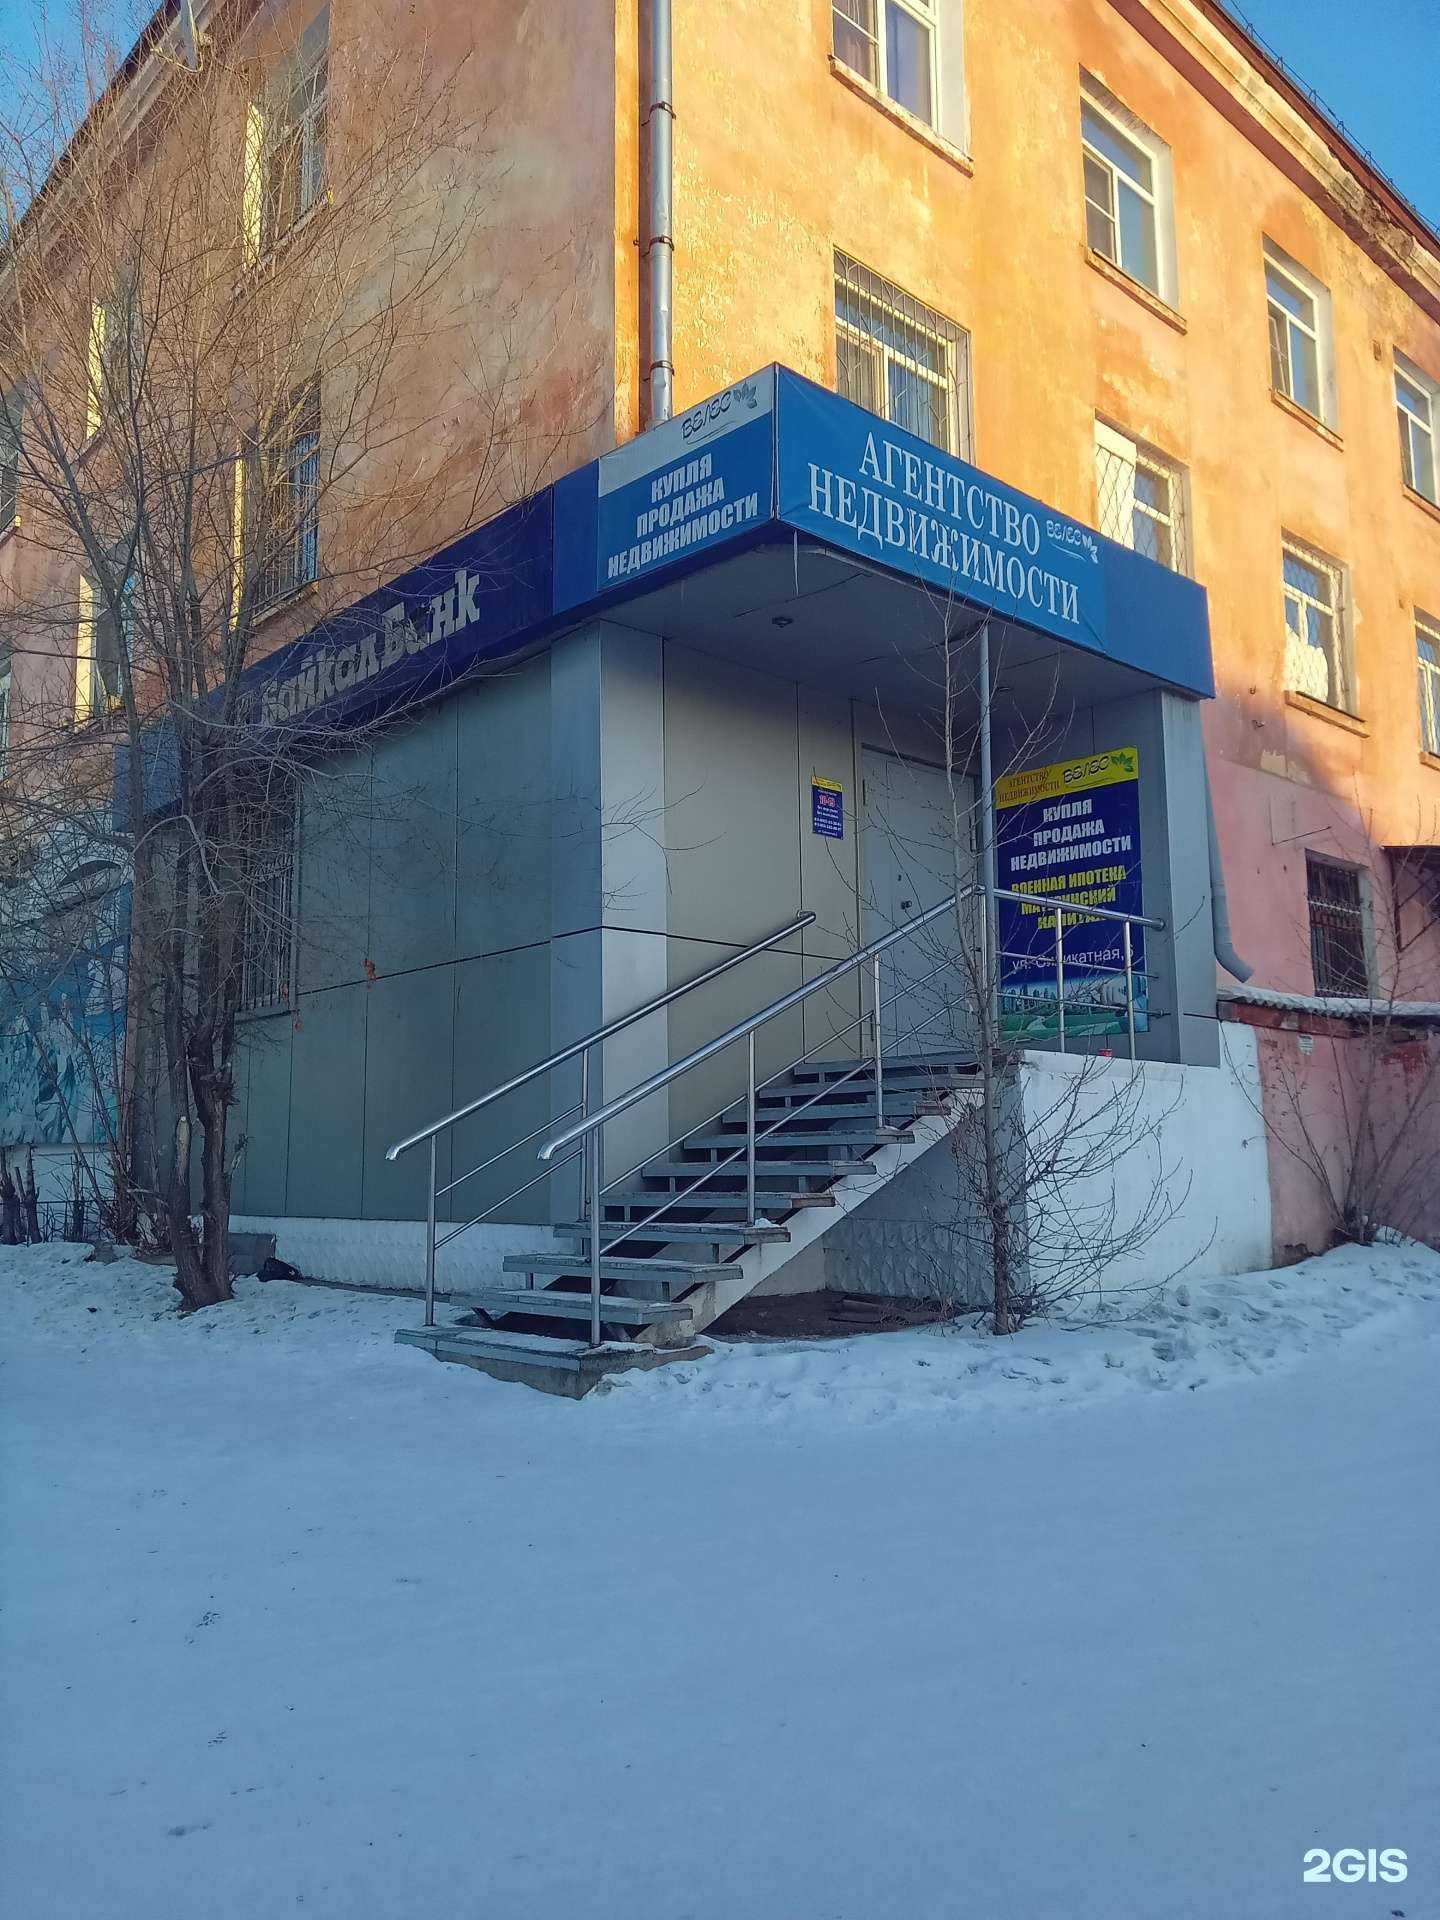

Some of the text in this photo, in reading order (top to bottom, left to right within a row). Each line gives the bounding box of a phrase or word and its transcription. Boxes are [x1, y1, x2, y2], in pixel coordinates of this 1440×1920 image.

[651, 452, 712, 504] КУПЛЯ
[858, 431, 1041, 556] АГЕНТСТВО
[636, 476, 725, 538] ПРОДАЖА
[607, 492, 758, 579] НЕДВИЖИМОСТИ
[807, 462, 1080, 625] НЕДВИЖИМОСТИ
[1043, 798, 1093, 823] КУПЛЯ
[1033, 818, 1105, 847] ПРОДАЖА
[1010, 835, 1132, 872] НЕДВИЖИМОСТИ
[1011, 865, 1127, 897] ВОЕННАЯ ИПОТЕКА
[1021, 884, 1117, 915] МАИНСКИЙ
[1035, 947, 1125, 969] Сиикатная,
